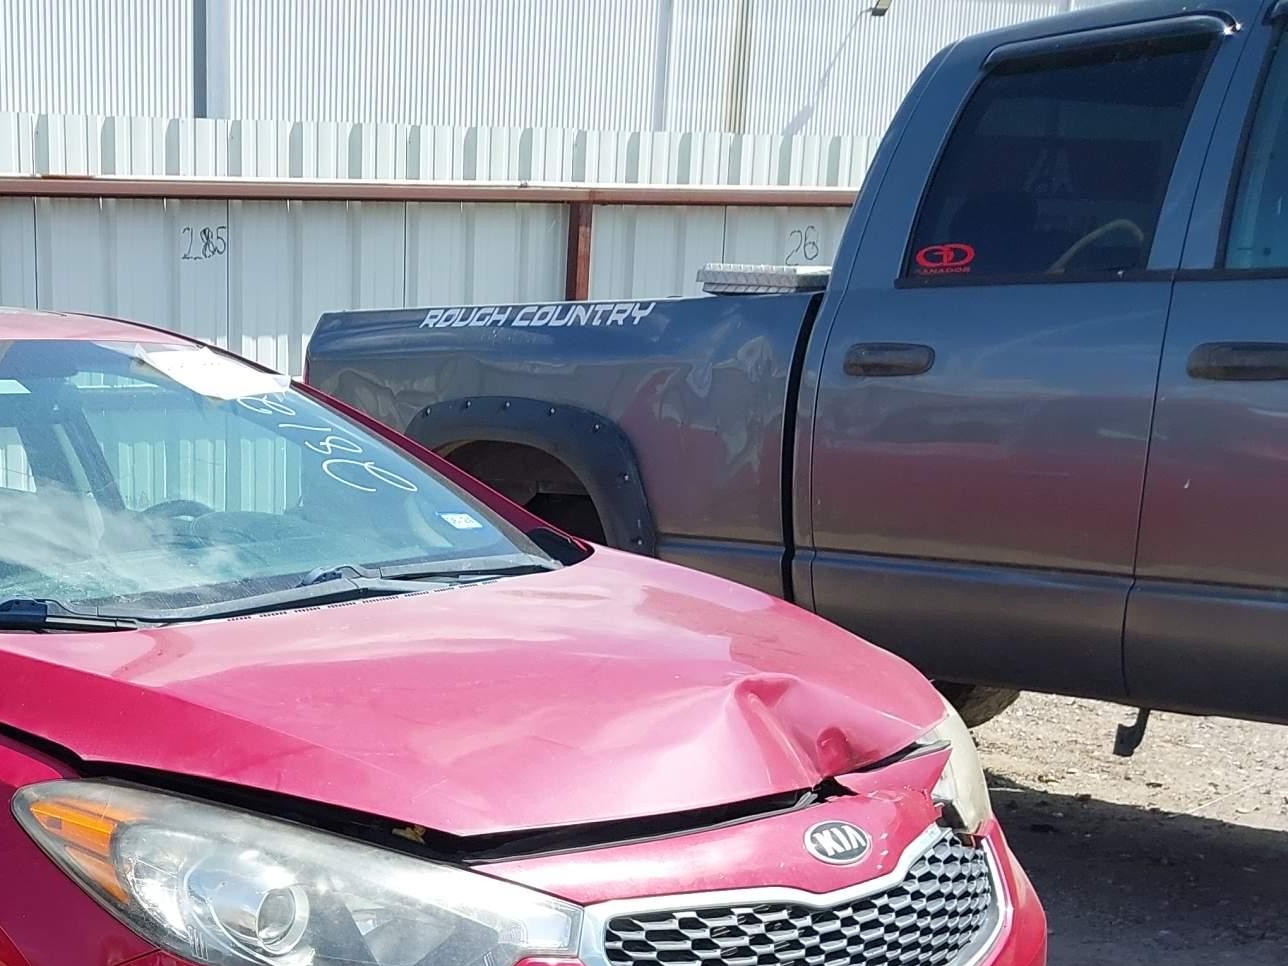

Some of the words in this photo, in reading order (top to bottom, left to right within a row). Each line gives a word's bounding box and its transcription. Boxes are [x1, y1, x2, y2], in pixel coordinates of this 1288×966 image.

[785, 225, 819, 266] 26
[419, 306, 512, 328] ROUGH
[512, 302, 656, 326] COUNTRY
[812, 825, 867, 857] KIA
